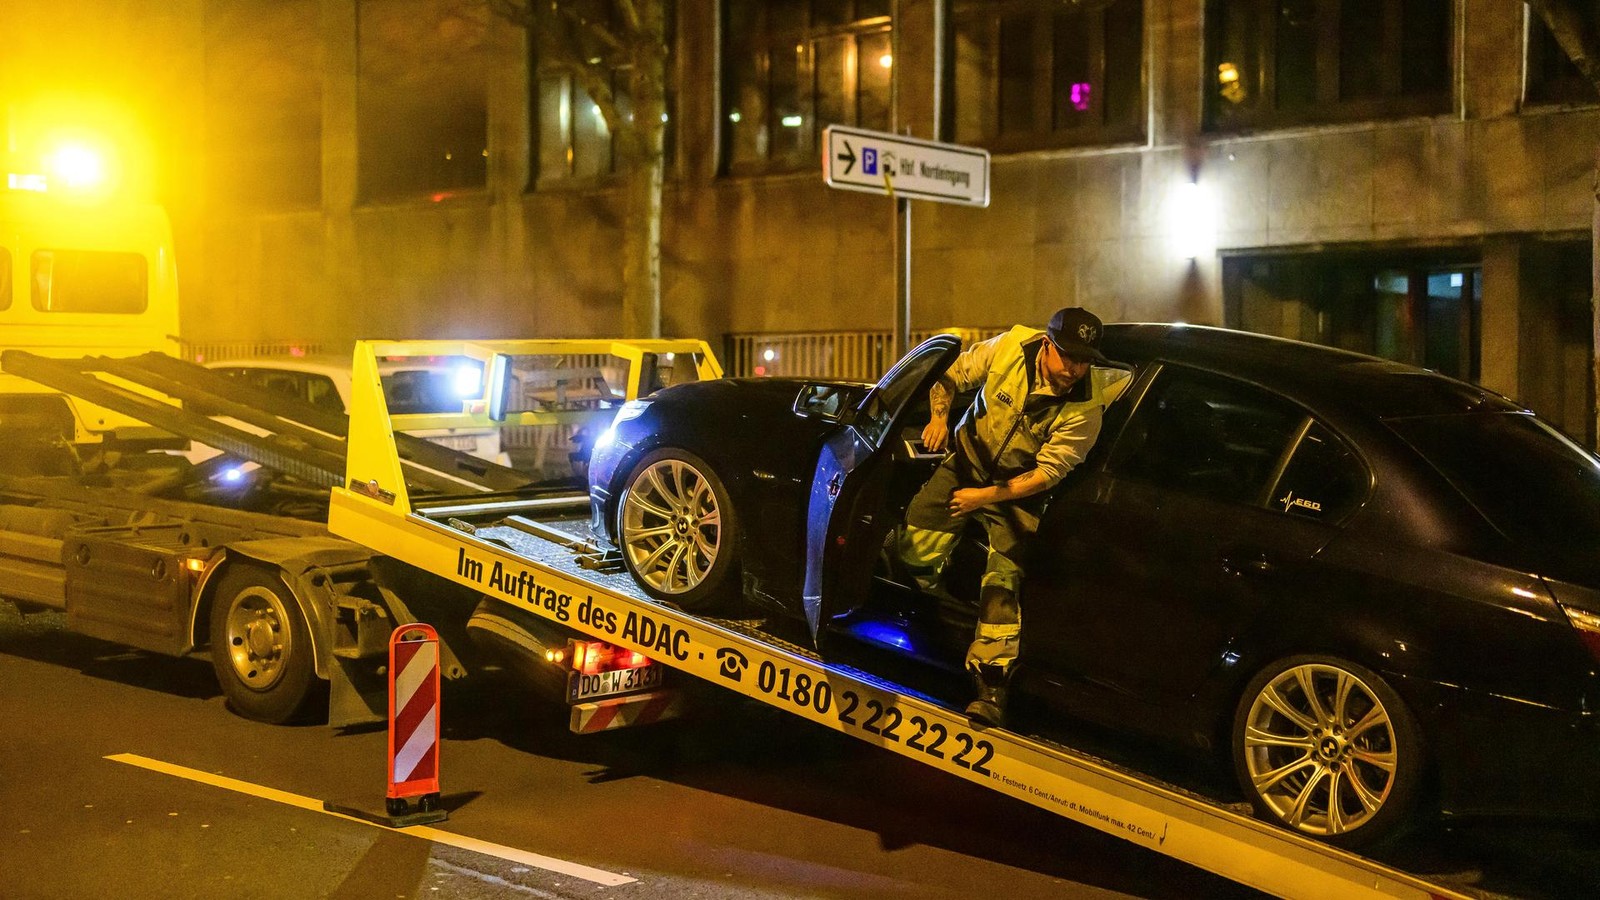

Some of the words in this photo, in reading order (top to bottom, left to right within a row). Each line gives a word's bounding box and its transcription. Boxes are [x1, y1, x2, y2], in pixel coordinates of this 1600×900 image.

[996, 392, 1014, 407] ADAC
[457, 548, 483, 583] Im
[488, 561, 572, 622] Auftrag
[577, 595, 617, 634] des
[621, 611, 690, 661] ADAC
[758, 661, 832, 714] 0180
[838, 690, 860, 726] 2
[862, 699, 904, 742] 22
[906, 715, 948, 760] 22
[951, 732, 994, 777] 22
[580, 674, 601, 694] DO
[611, 670, 622, 692] W
[1002, 775, 1027, 791] Festnetz
[1028, 786, 1034, 794] 6
[1078, 804, 1109, 823] Mobilfunk
[1110, 818, 1125, 829] max.
[1126, 823, 1135, 833] 42
